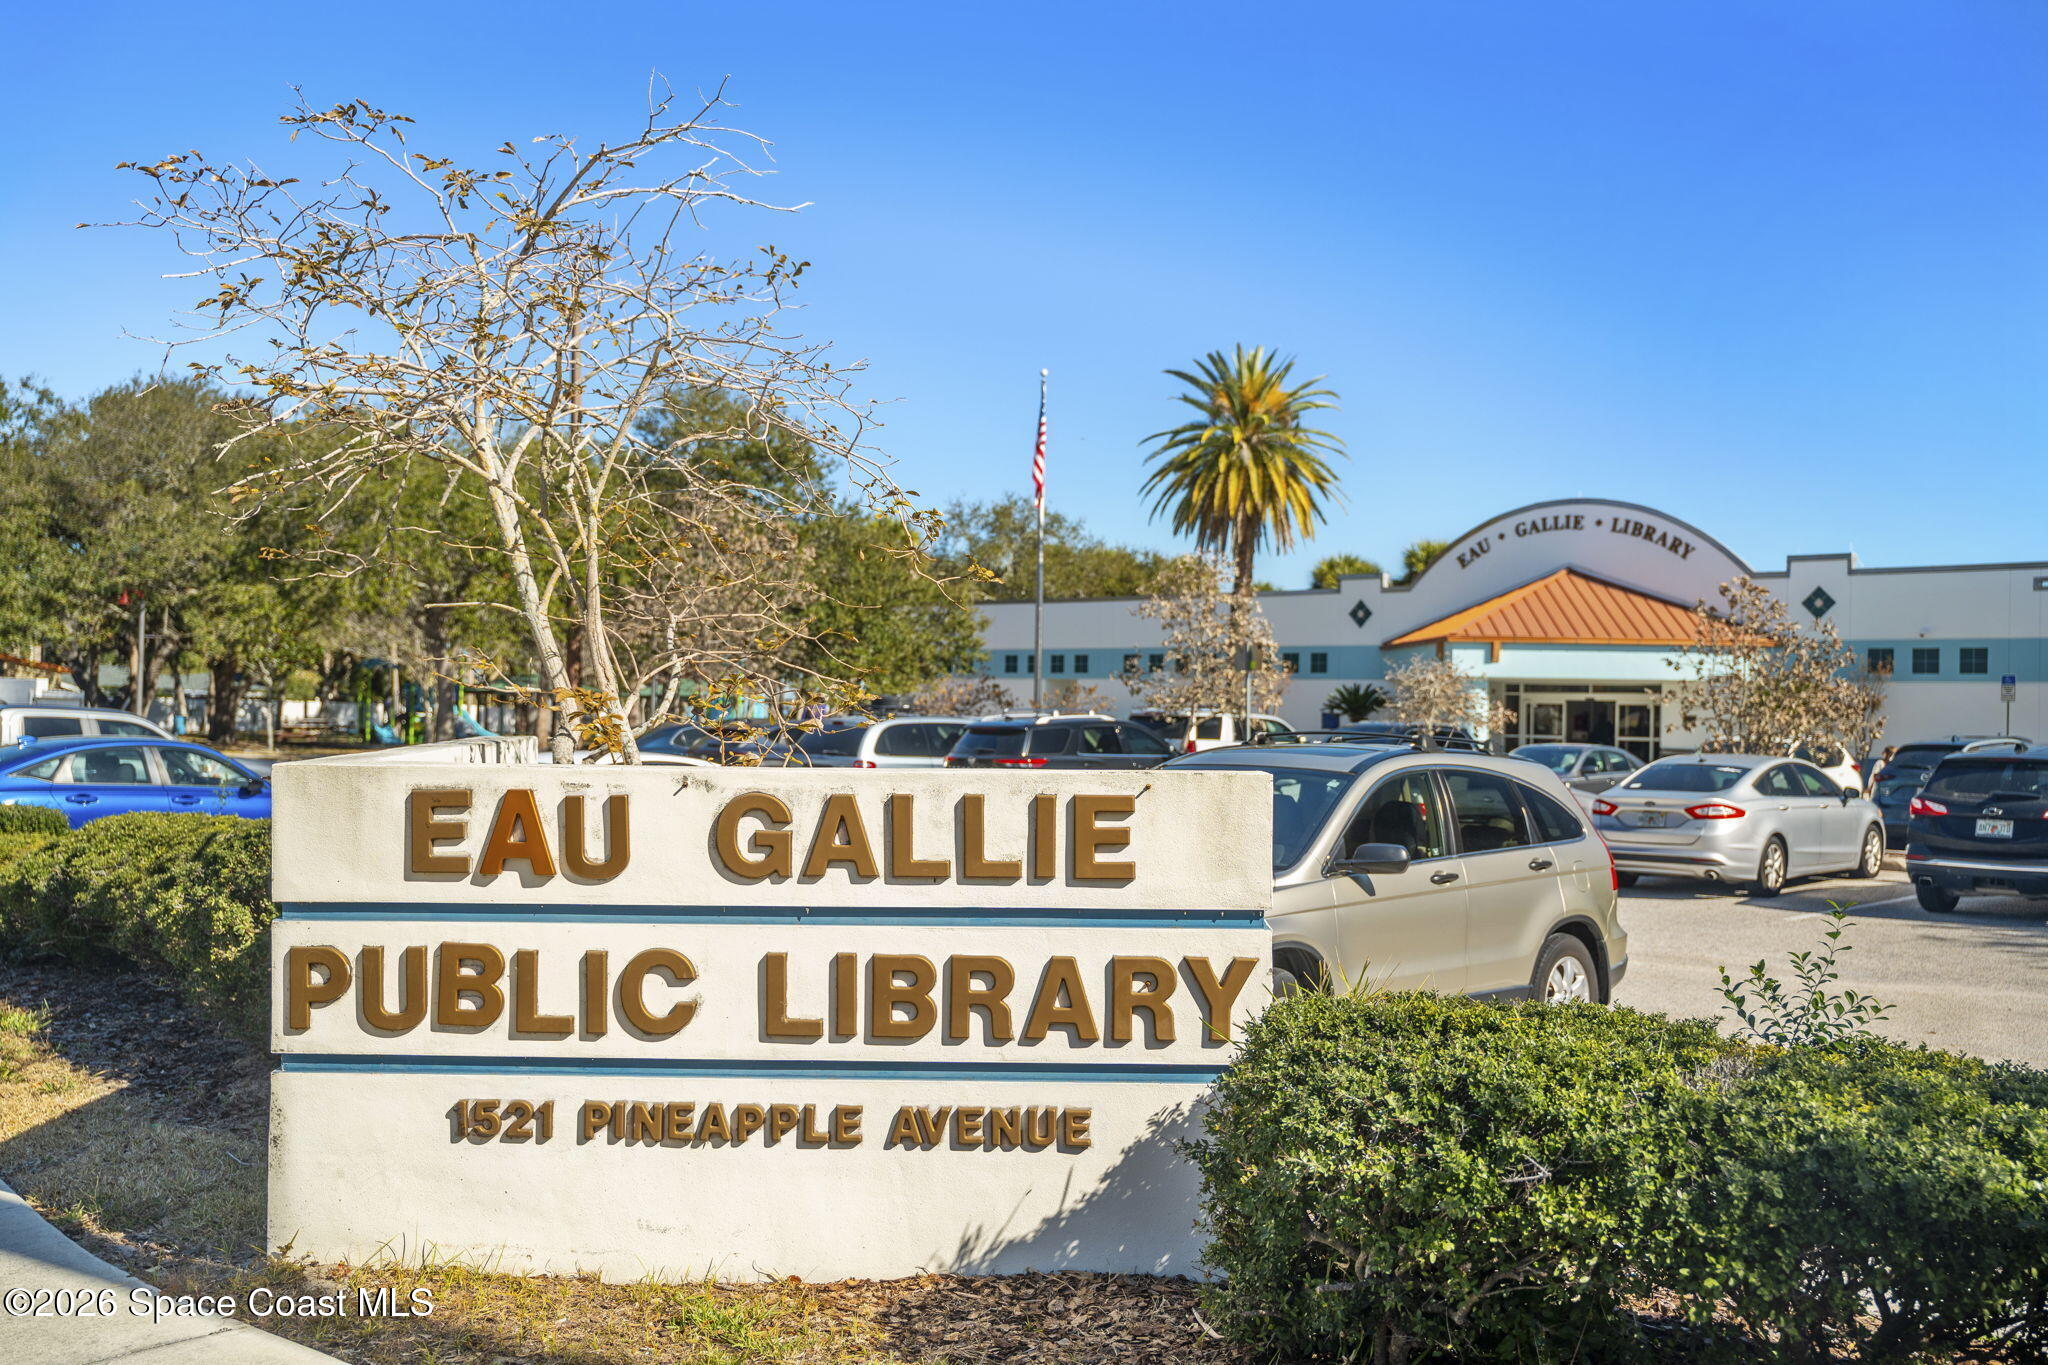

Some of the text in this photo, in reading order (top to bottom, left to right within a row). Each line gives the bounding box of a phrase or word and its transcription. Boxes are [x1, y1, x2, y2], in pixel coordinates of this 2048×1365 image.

[1456, 515, 1697, 569] EAU GALLIE LIBRARY
[410, 788, 1136, 880] EAU GALLIE
[289, 941, 1260, 1042] PUBLIC LIBRARY
[453, 1099, 1093, 1148] 1521 PINEAPPLE AVENUE
